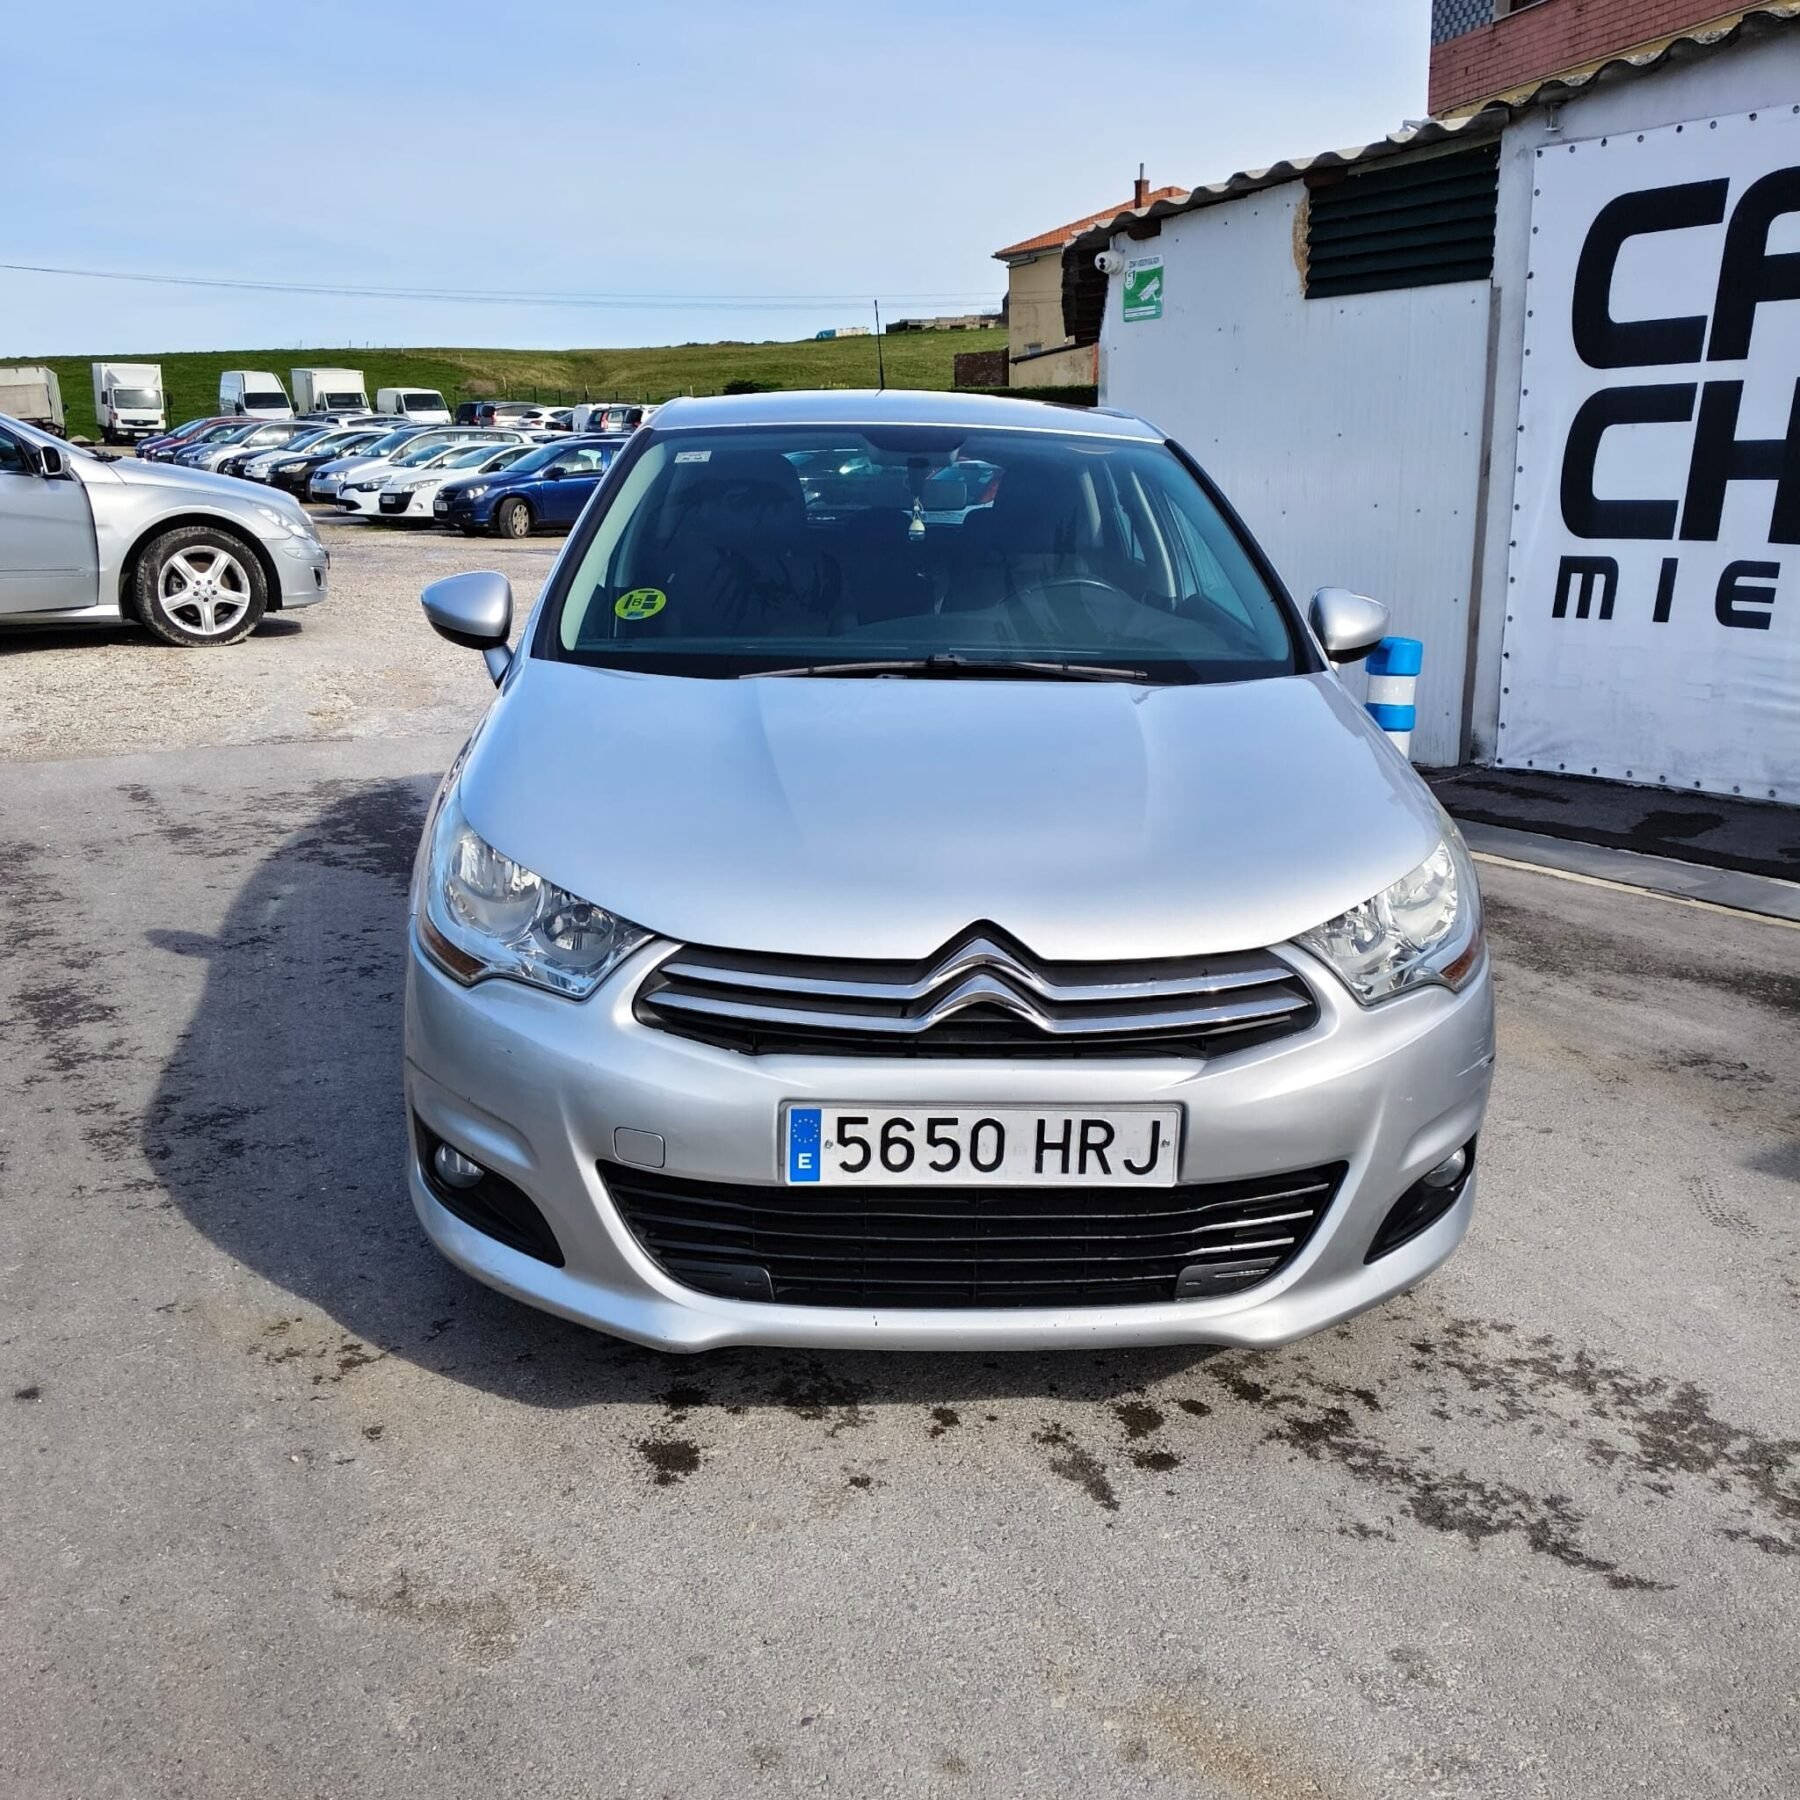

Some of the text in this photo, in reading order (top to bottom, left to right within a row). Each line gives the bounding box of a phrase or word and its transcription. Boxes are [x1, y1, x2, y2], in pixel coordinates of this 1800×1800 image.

[1560, 377, 1800, 544] CH
[798, 1152, 812, 1169] E
[836, 1115, 1161, 1176] 5650 HRJ
